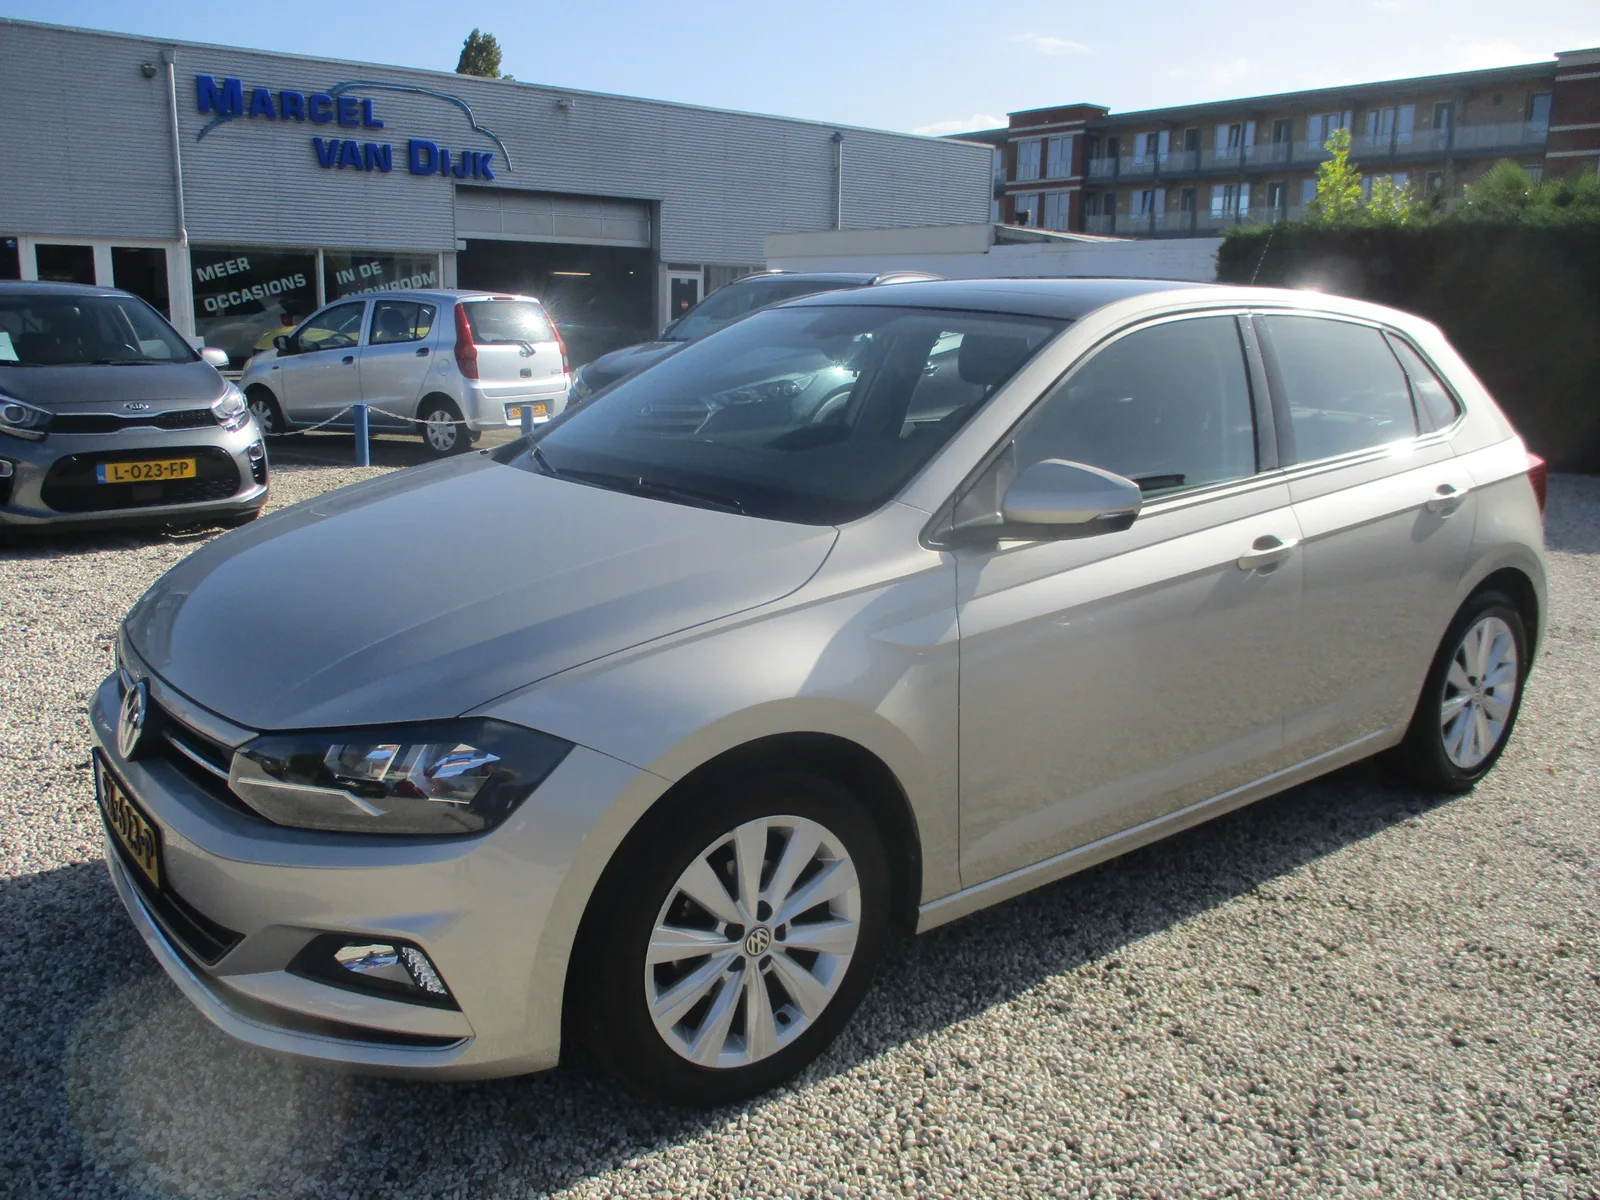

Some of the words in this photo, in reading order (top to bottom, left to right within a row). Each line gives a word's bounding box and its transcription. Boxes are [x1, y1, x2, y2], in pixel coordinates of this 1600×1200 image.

[196, 75, 385, 130] MARCEL
[313, 136, 393, 173] VAN
[408, 138, 497, 180] DIJK
[196, 257, 251, 283] MEER
[335, 268, 356, 285] IN
[359, 261, 382, 278] DE
[204, 273, 307, 312] OCCASIONS
[114, 461, 189, 480] L-023-FP
